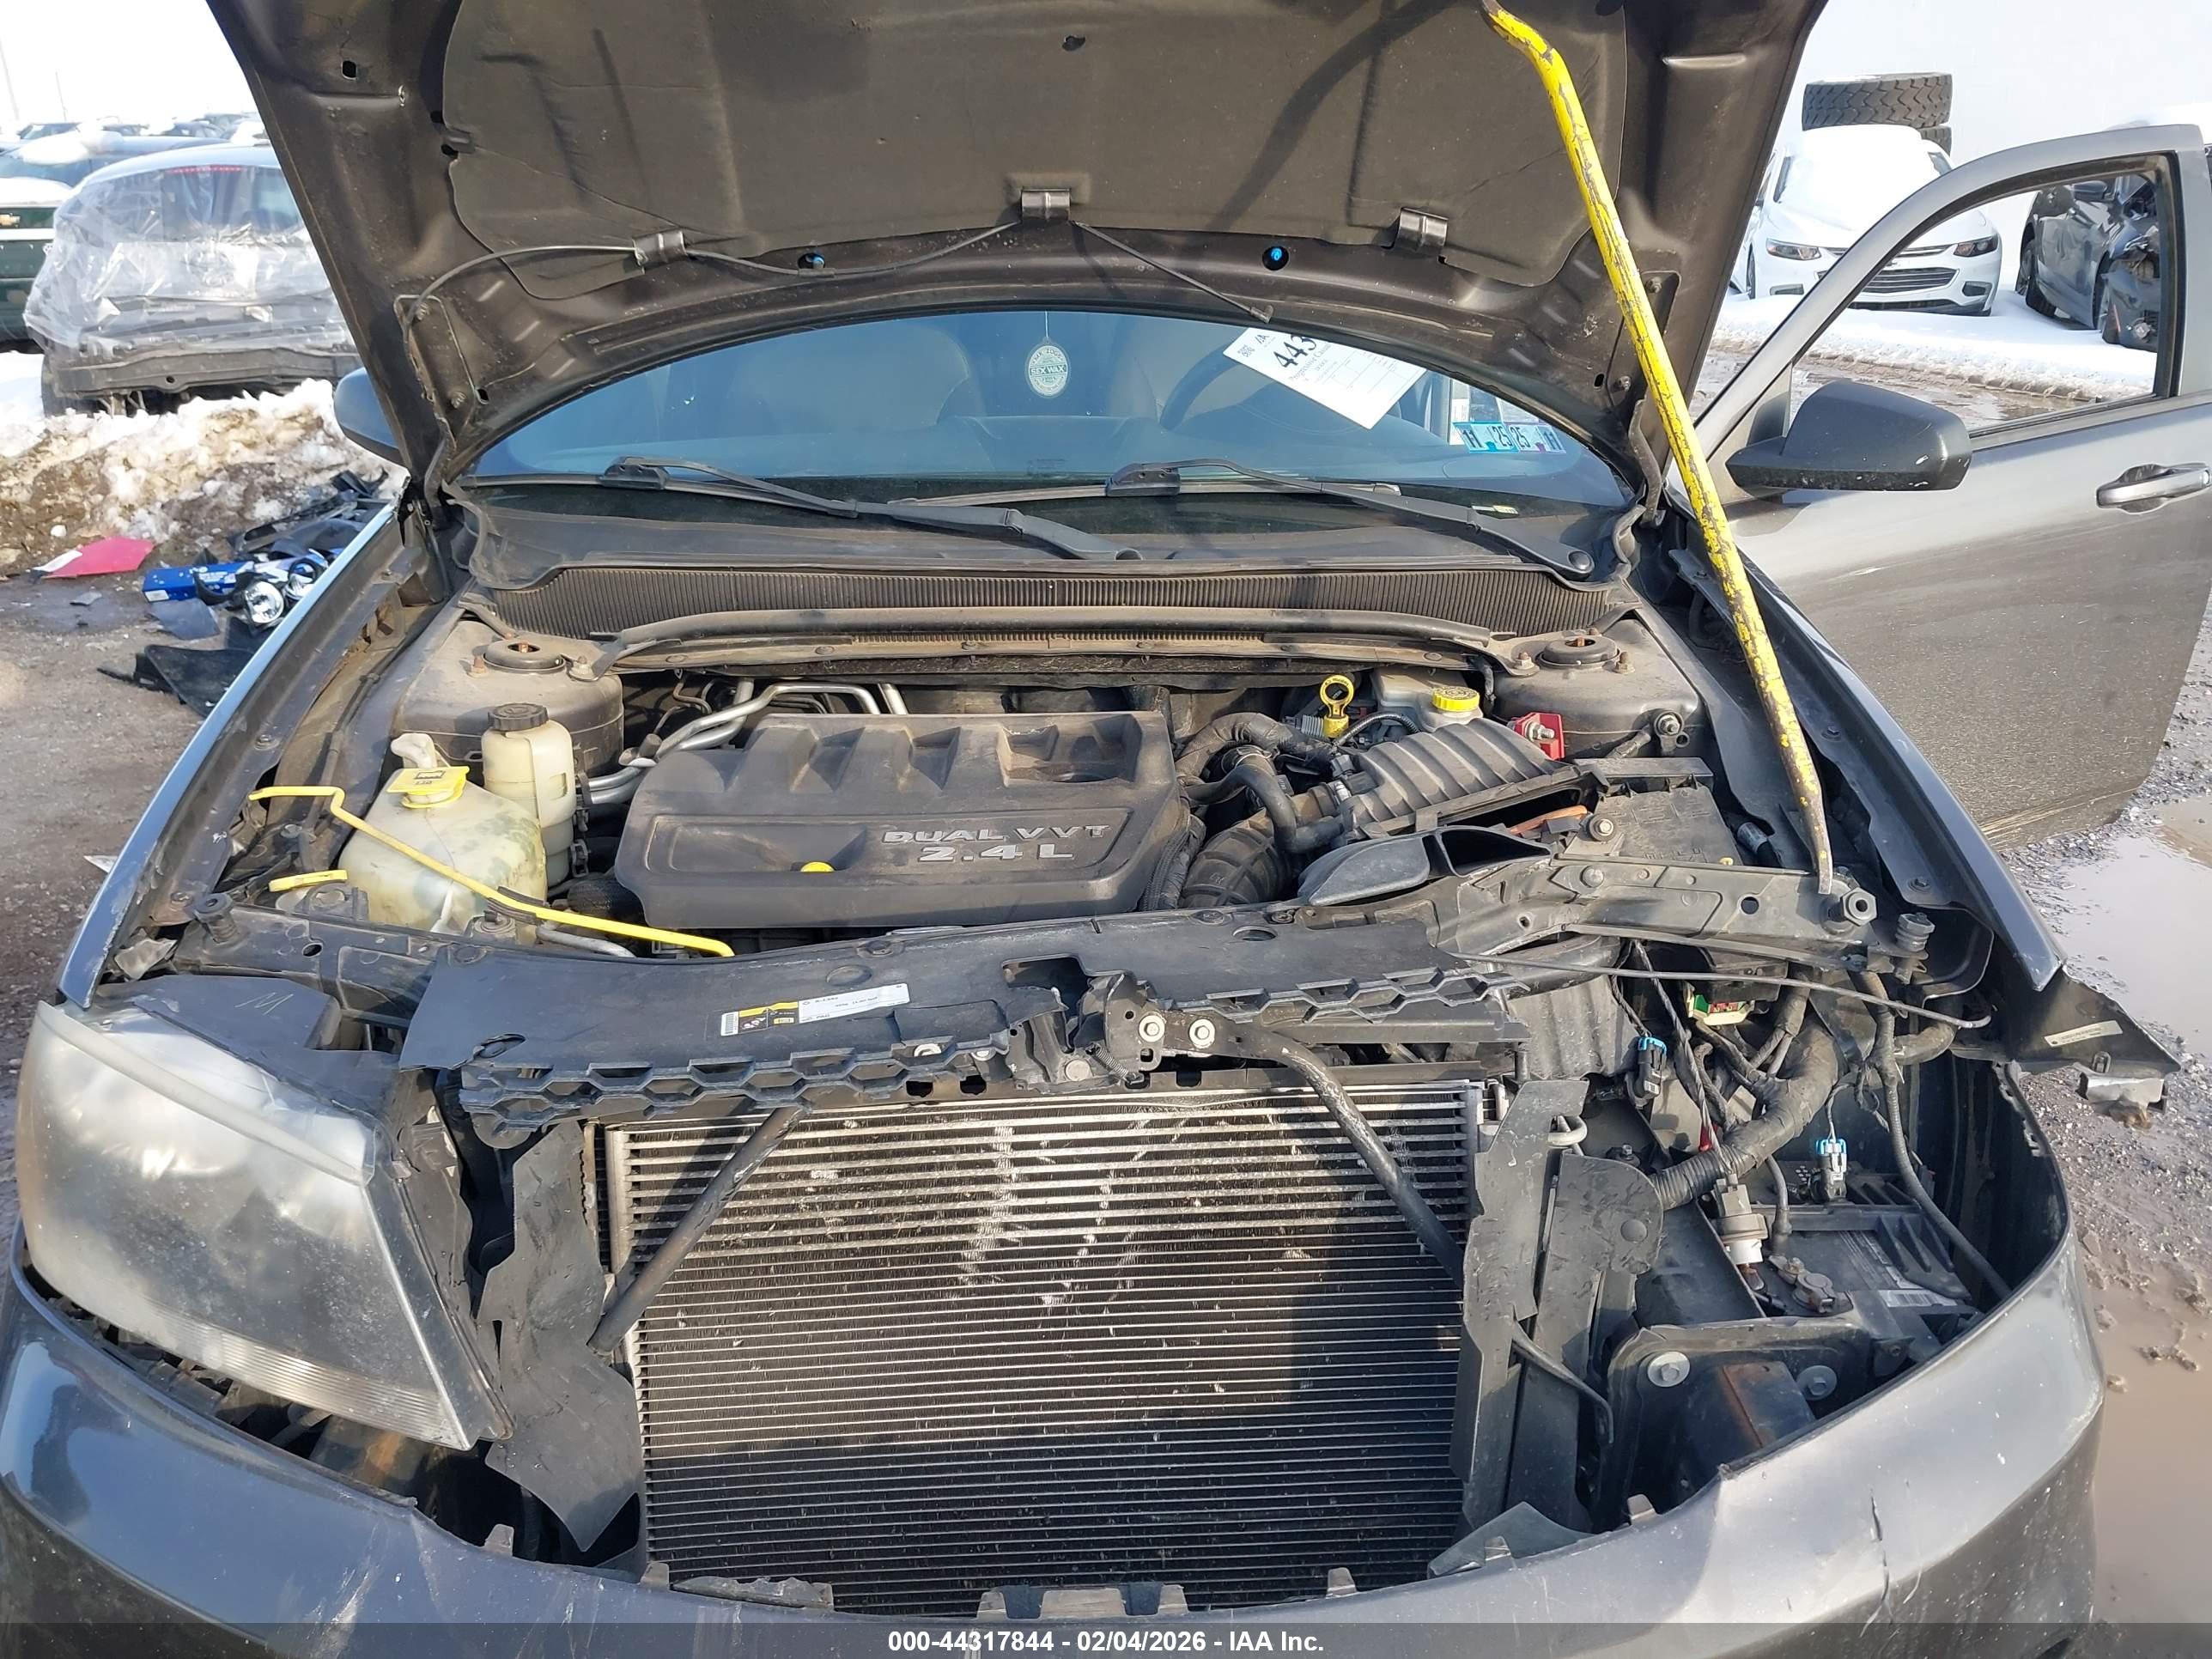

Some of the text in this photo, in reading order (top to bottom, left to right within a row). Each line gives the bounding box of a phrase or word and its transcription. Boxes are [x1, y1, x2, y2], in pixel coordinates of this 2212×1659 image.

[1492, 426, 1513, 447] 25
[1510, 426, 1531, 447] 25
[883, 824, 1111, 843] DUAL VVT
